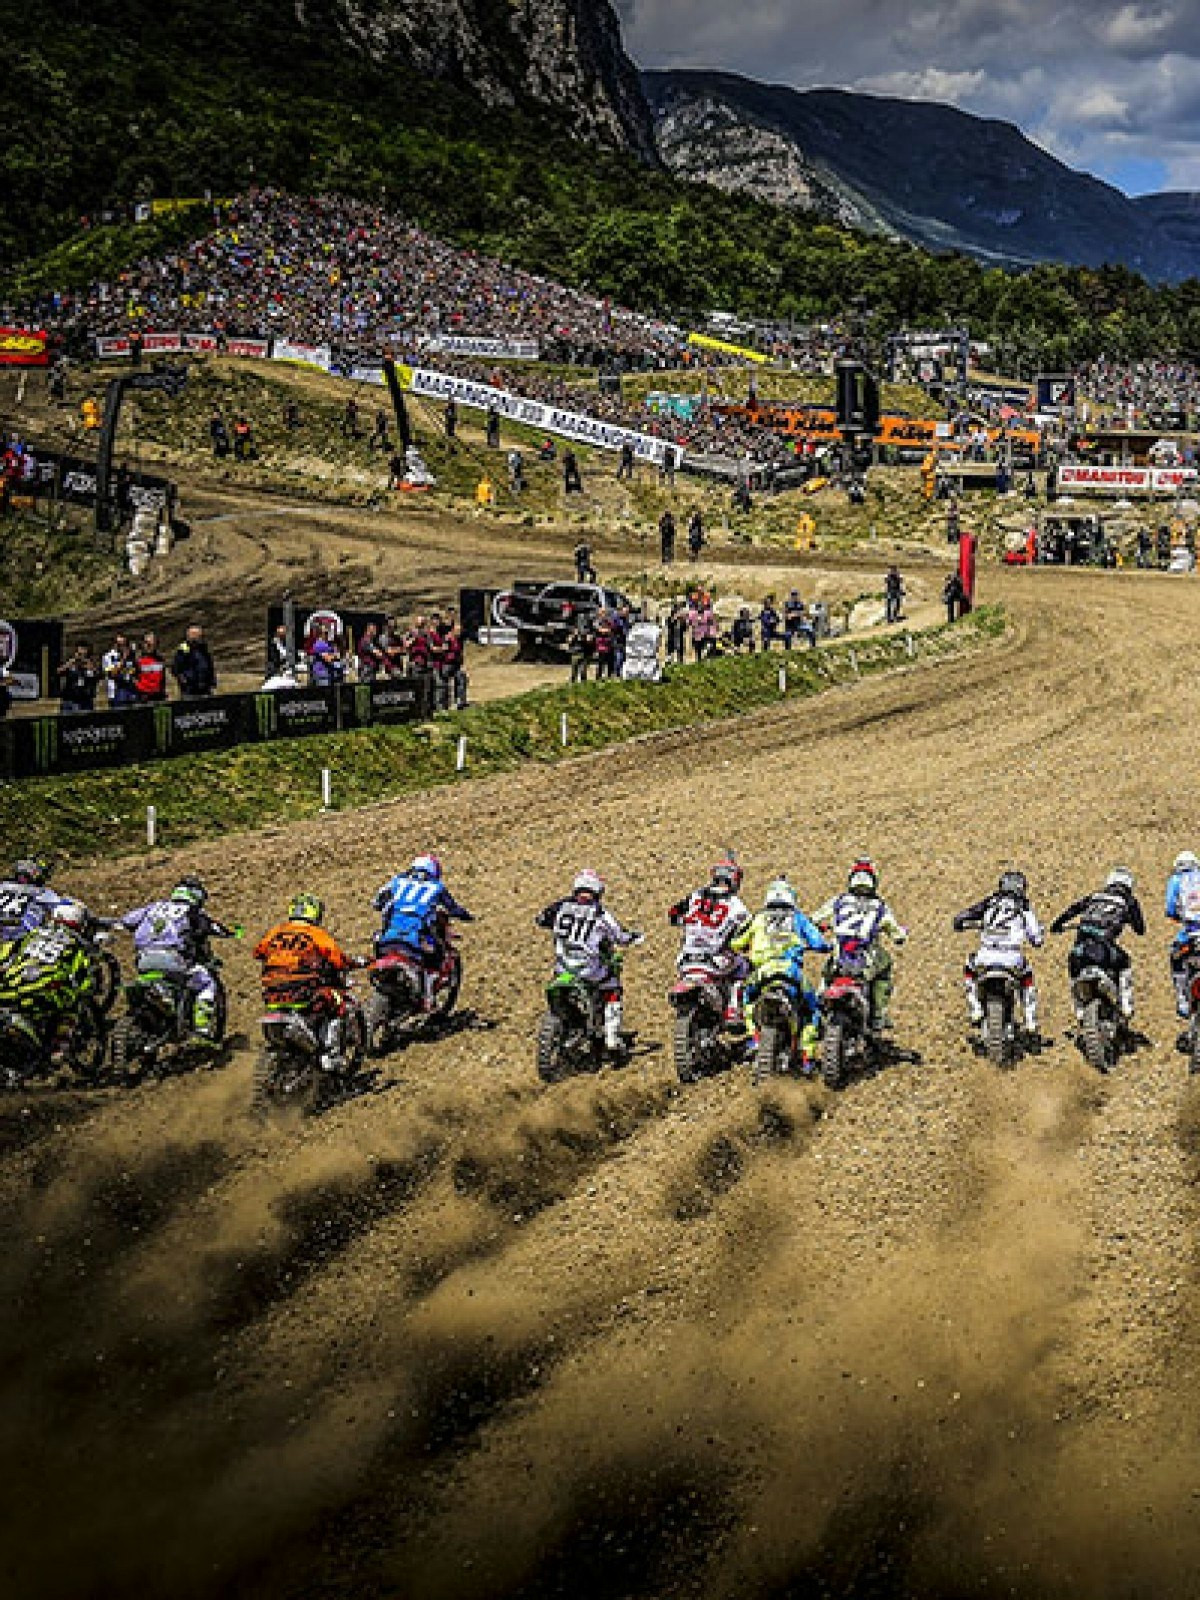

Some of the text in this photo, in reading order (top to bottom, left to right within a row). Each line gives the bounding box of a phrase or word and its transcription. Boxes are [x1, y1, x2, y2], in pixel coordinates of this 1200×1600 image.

[415, 372, 517, 416] MARANGONI
[550, 411, 652, 456] MARANGONI
[1074, 467, 1145, 485] MANITOU
[558, 913, 596, 943] 911
[835, 905, 877, 938] 21
